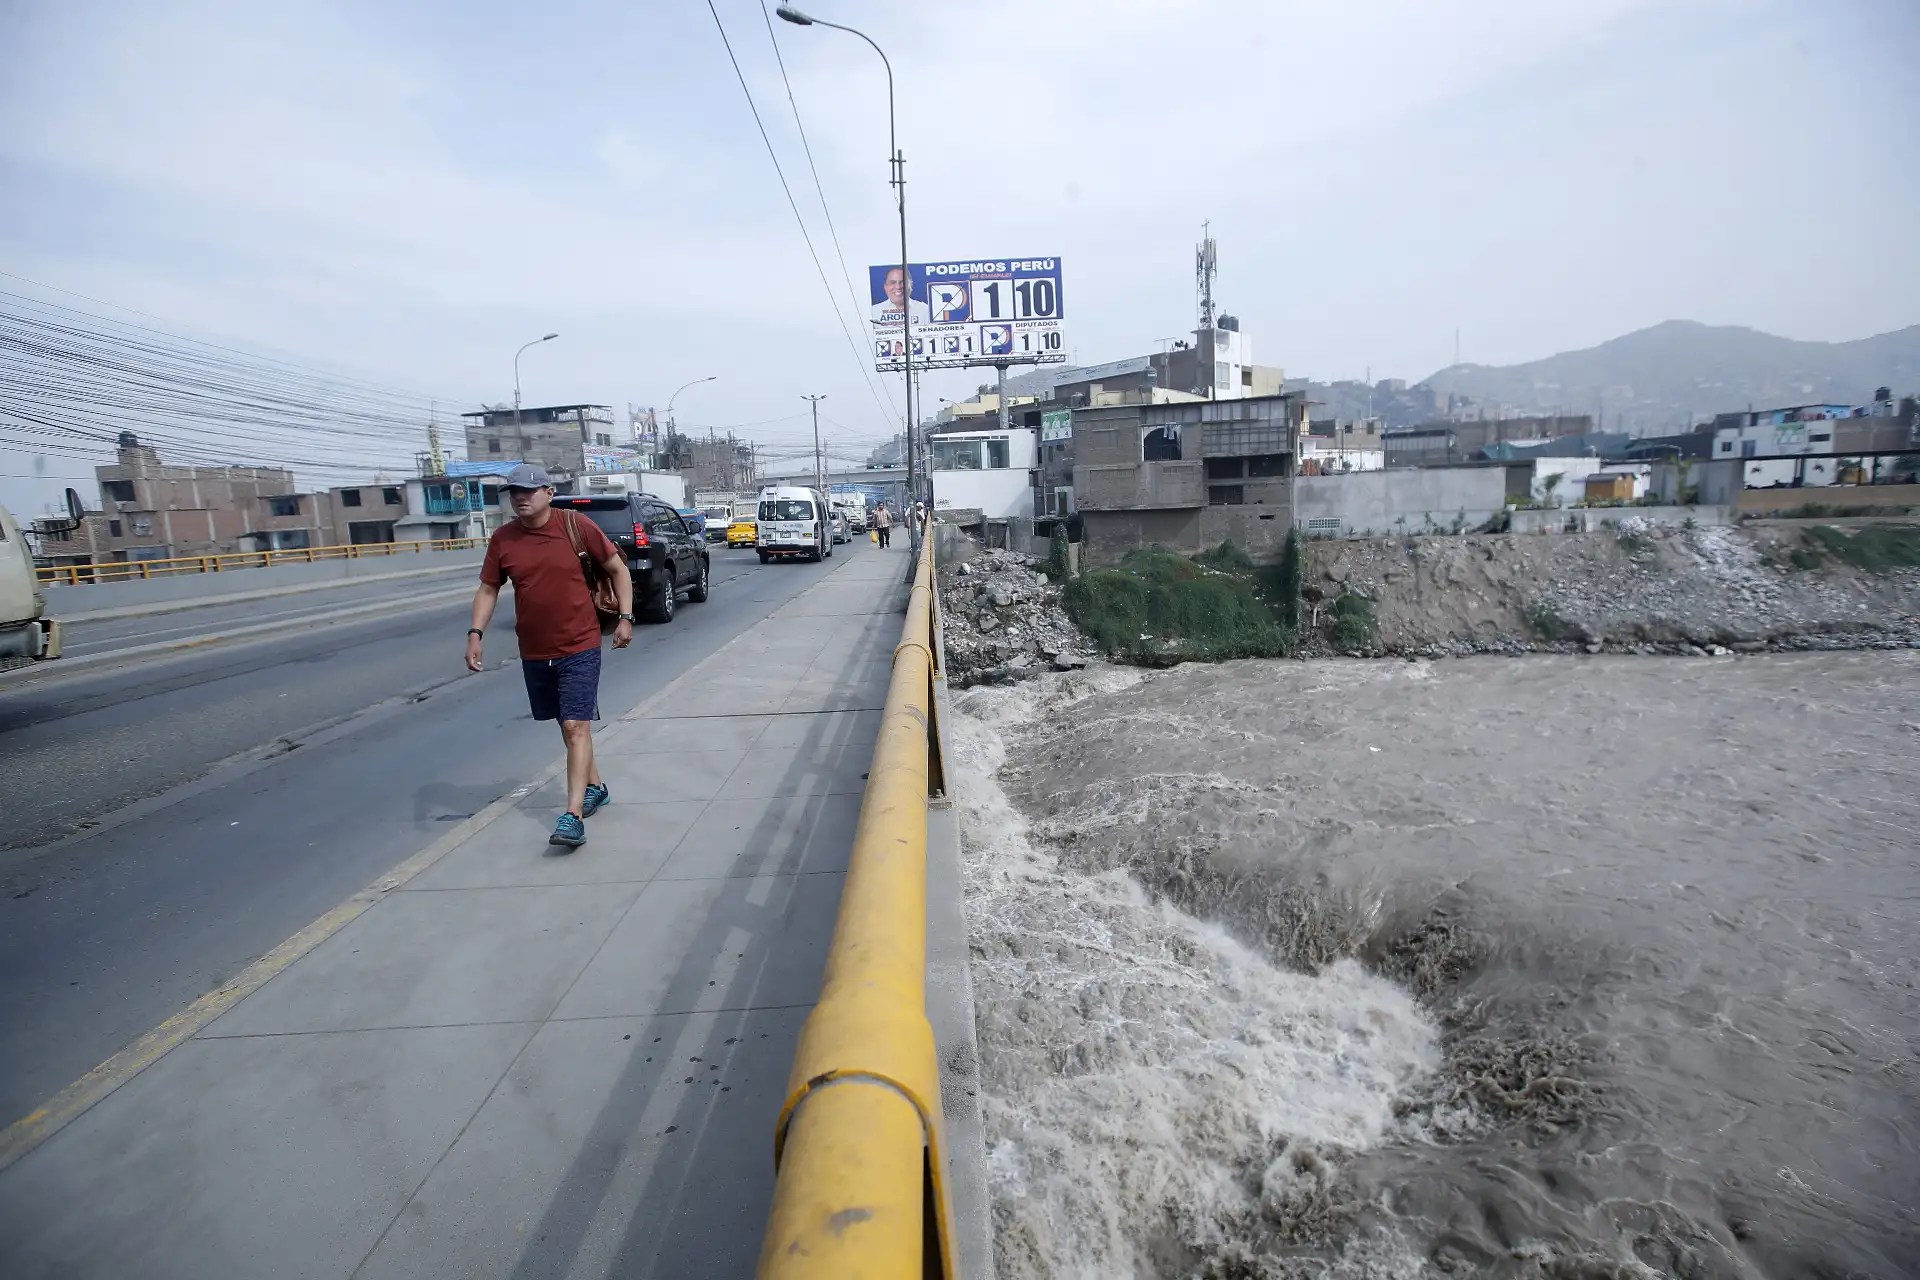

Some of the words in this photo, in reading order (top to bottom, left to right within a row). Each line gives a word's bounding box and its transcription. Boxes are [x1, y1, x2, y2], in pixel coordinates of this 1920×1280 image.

[925, 262, 1006, 276] PODEMOS
[1011, 258, 1055, 272] PERÚ
[983, 281, 999, 318] 1
[1015, 280, 1055, 317] 10
[917, 324, 965, 333] SENADORES
[1015, 320, 1058, 328] DIPUTADOS
[1042, 332, 1061, 350] 10
